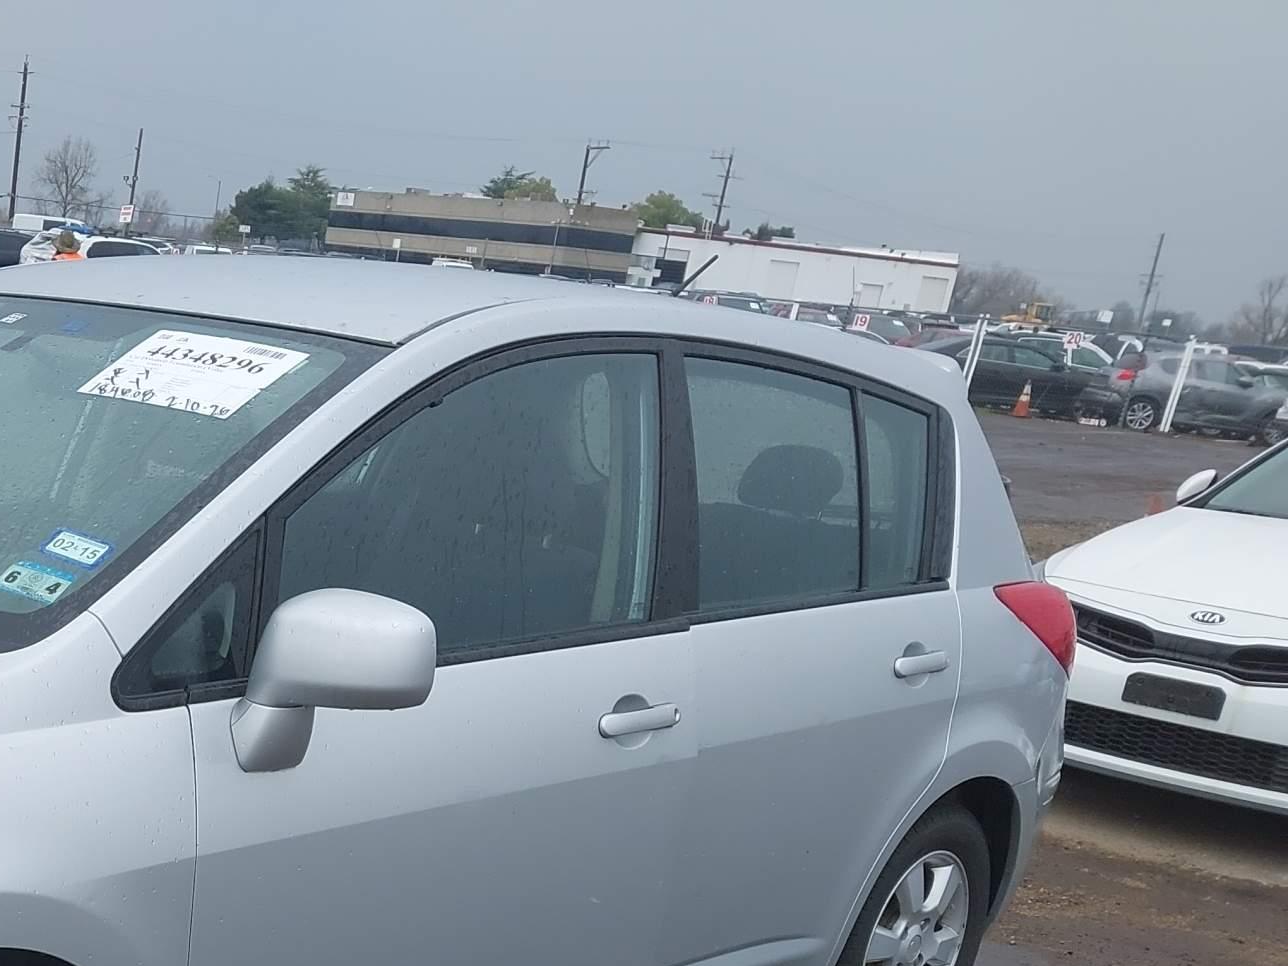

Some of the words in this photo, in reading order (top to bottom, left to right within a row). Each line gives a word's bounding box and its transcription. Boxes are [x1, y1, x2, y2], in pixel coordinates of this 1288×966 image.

[855, 315, 868, 327] 19
[1067, 332, 1081, 345] 20
[147, 345, 268, 375] 44348296
[4, 571, 21, 584] 6
[45, 582, 62, 595] 4
[1194, 612, 1221, 624] KIA
